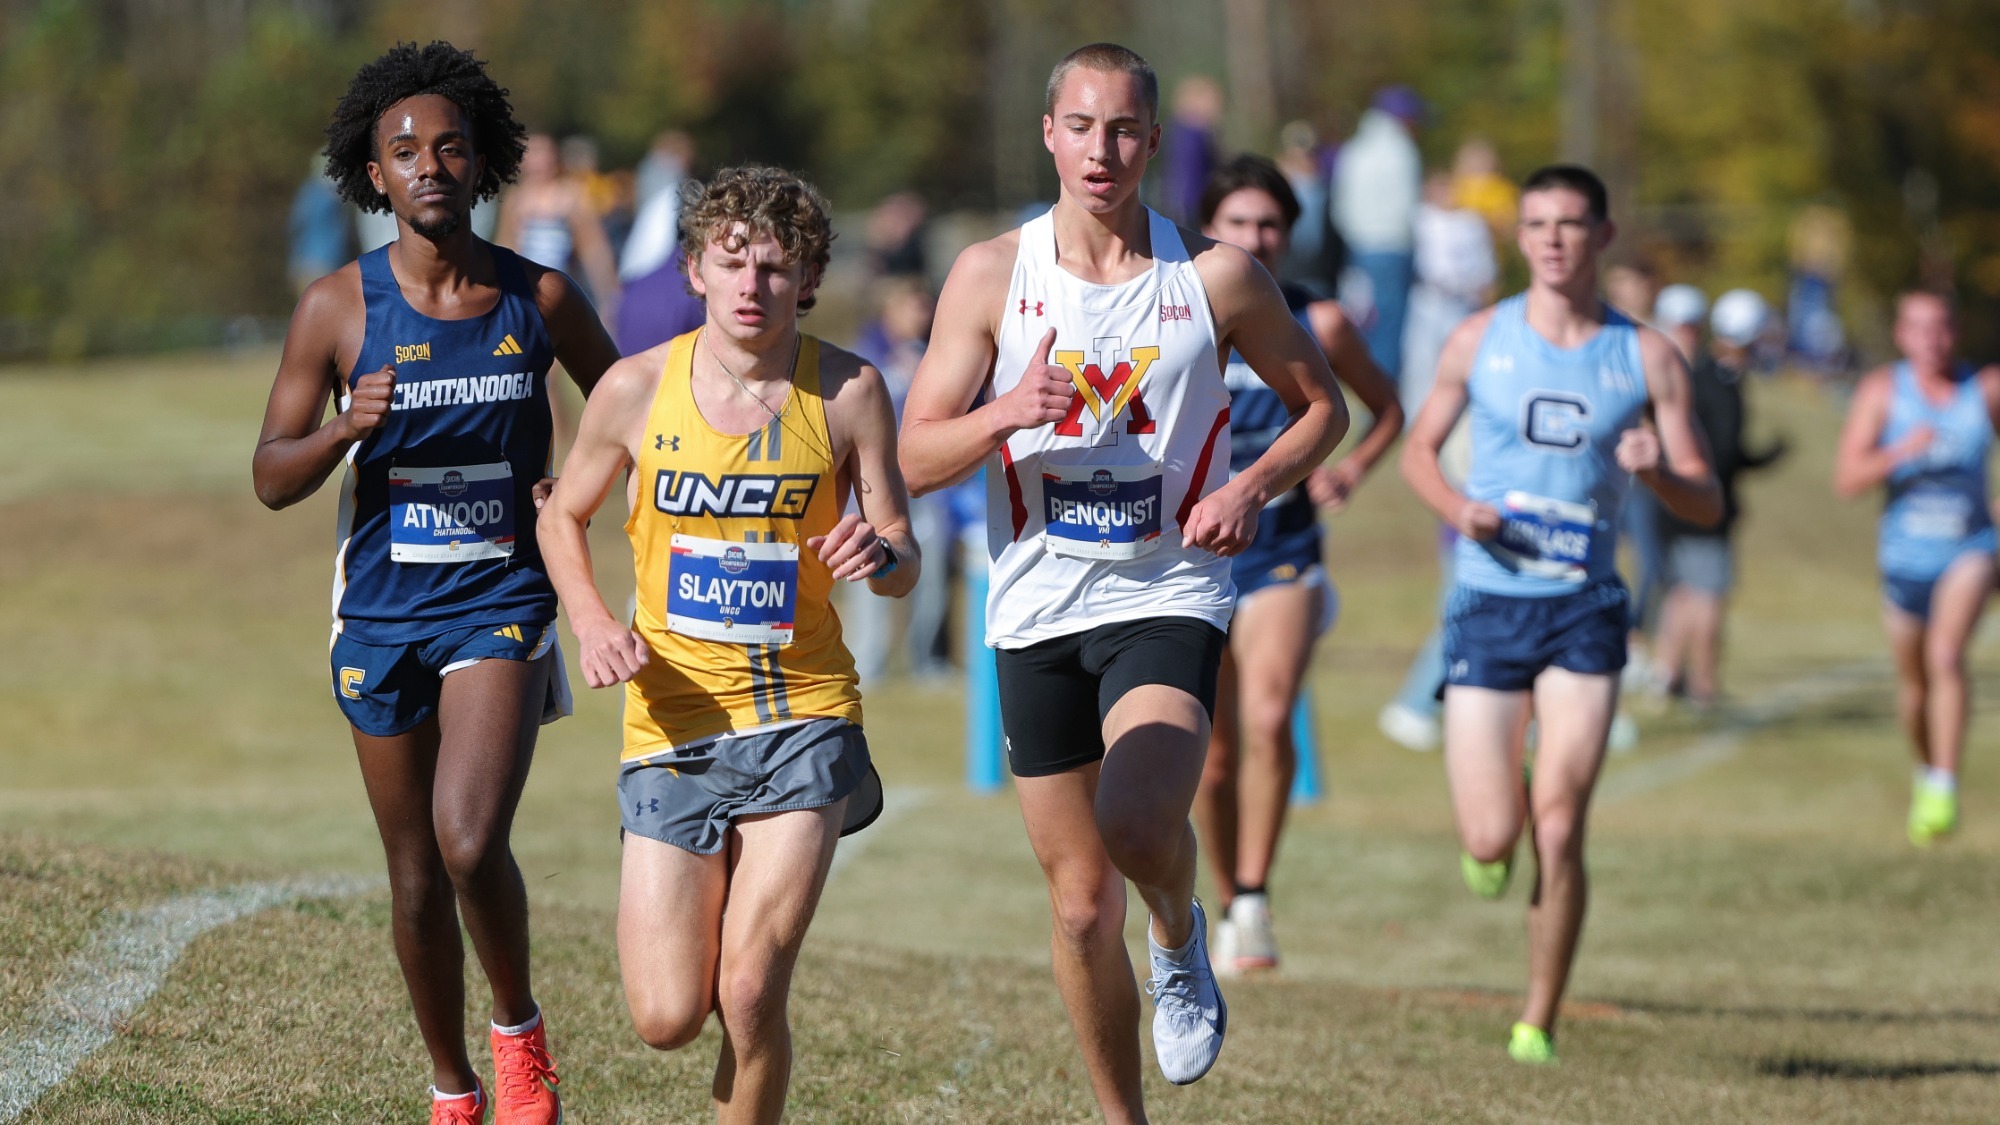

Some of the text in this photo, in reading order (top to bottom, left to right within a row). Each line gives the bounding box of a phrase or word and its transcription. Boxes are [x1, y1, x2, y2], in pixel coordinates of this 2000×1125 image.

[391, 372, 534, 411] CHATTANOOGA
[654, 469, 820, 520] UNCG
[403, 499, 504, 528] ATWOOD
[1050, 495, 1157, 527] RENQUIST
[433, 526, 476, 537] CHATTANOOGA
[678, 572, 785, 608] SLAYTON
[720, 605, 741, 615] UNCG
